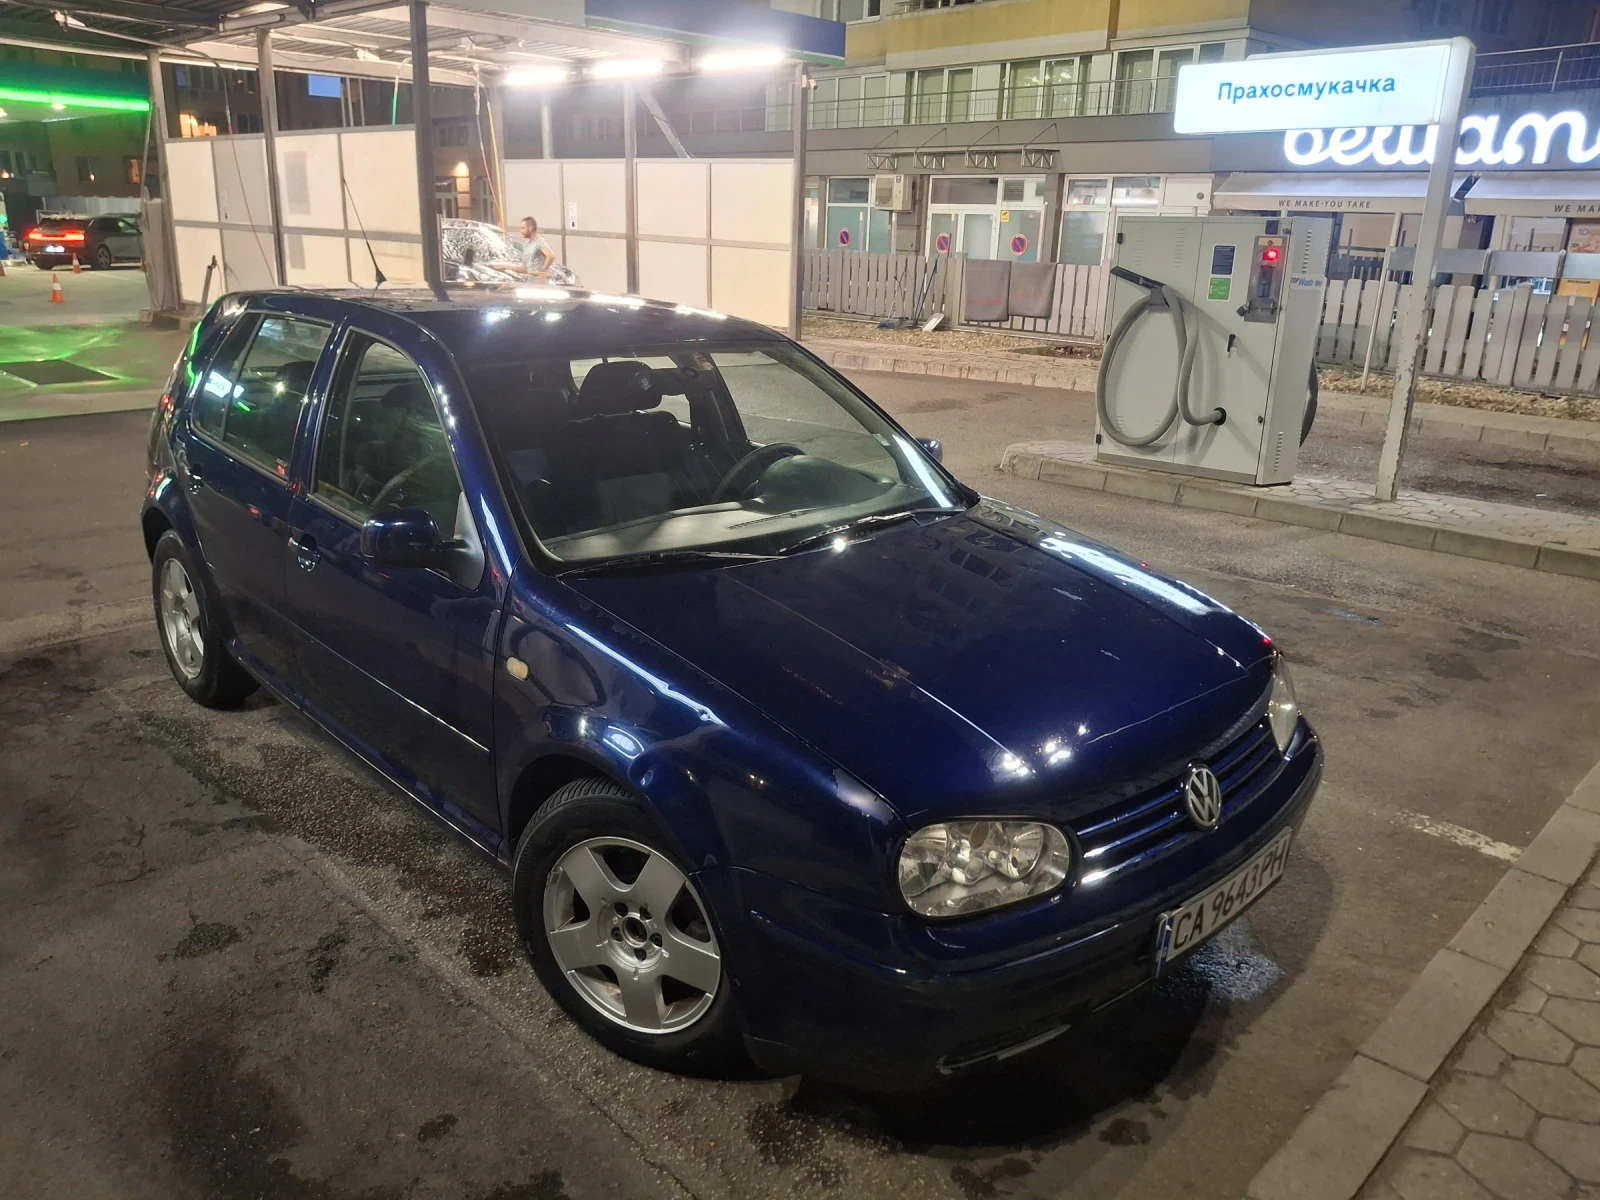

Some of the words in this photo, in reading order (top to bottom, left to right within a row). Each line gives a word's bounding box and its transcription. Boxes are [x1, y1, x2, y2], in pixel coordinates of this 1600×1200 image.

[1217, 77, 1396, 104] Прахосмукачка
[1295, 200, 1343, 208] MAKE-YOU
[1554, 204, 1571, 213] WE
[1188, 767, 1222, 827] VW
[1173, 903, 1205, 949] CA
